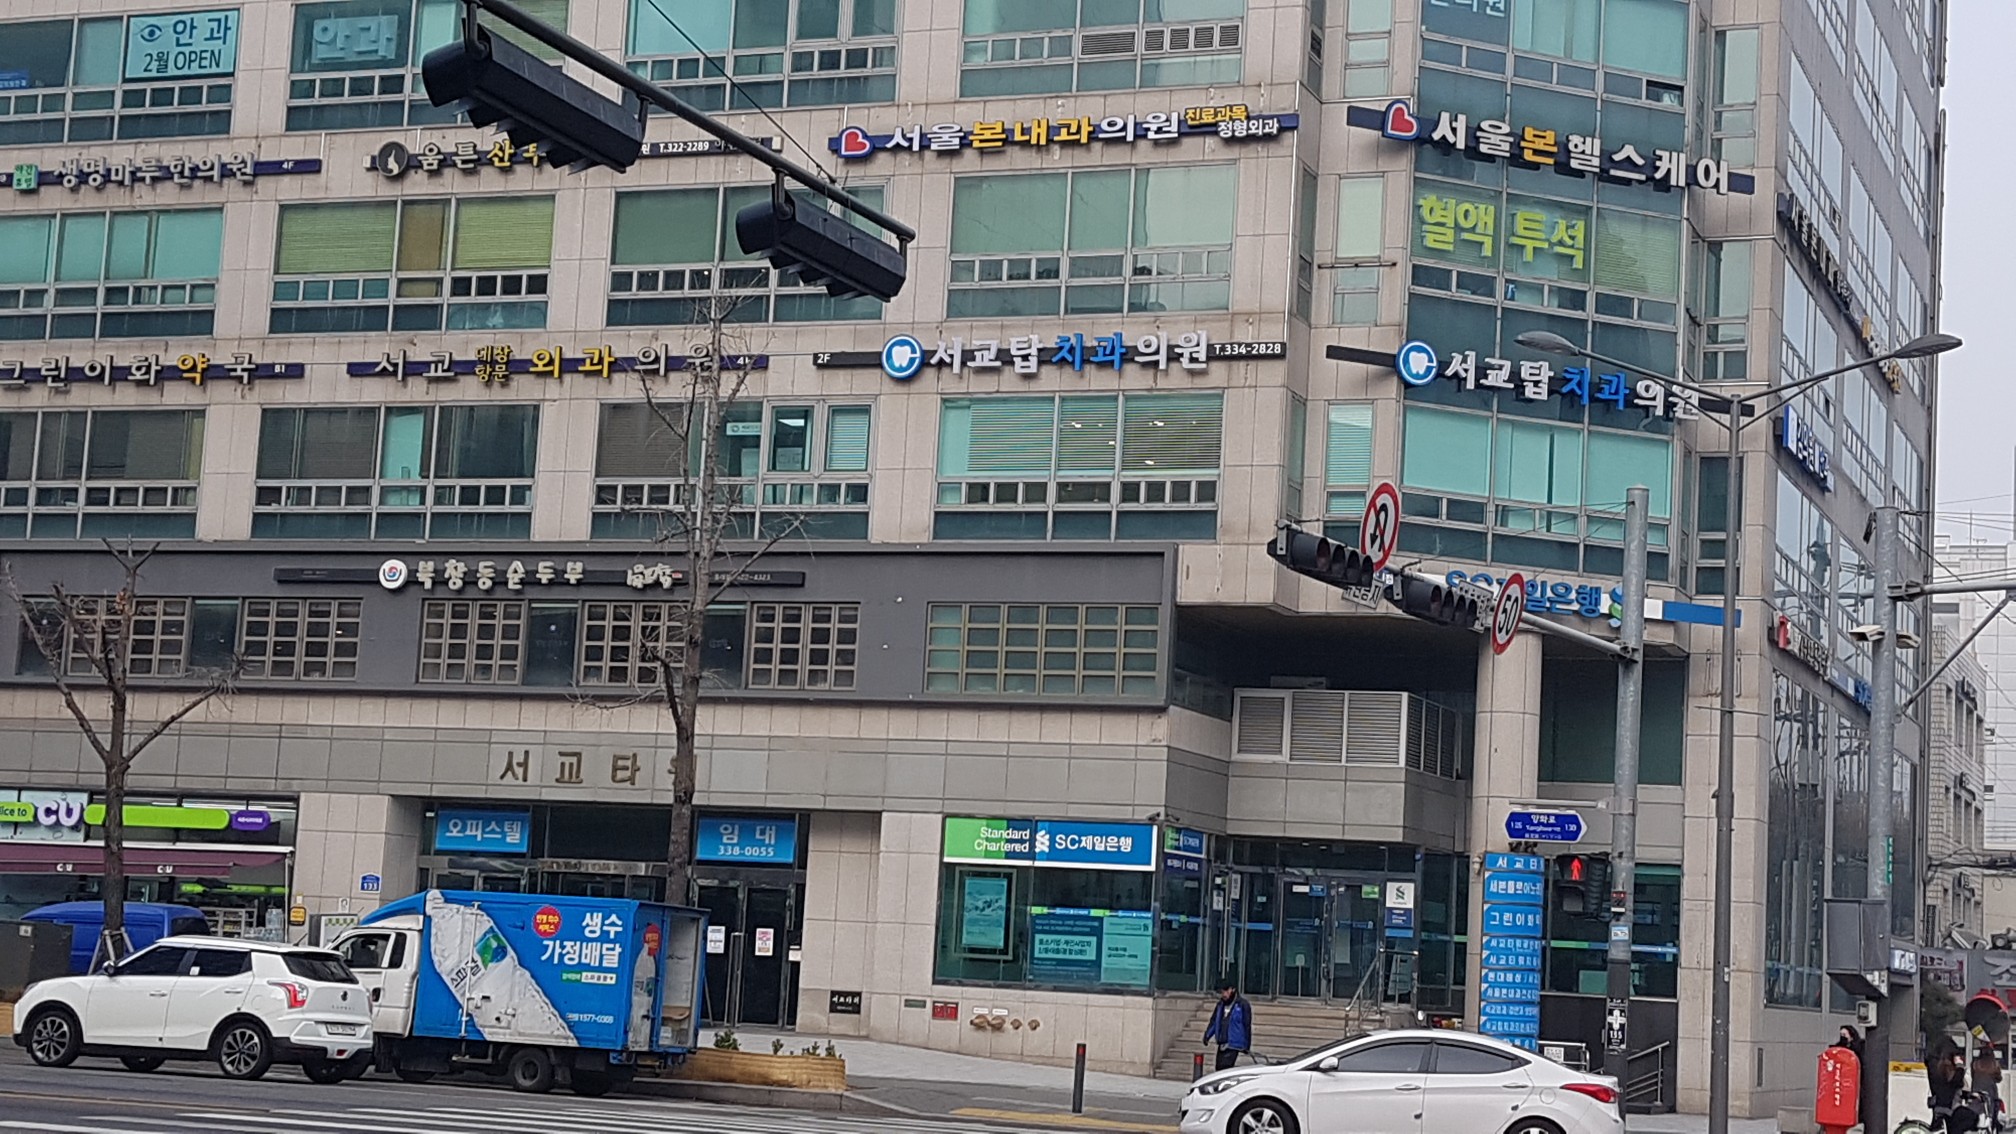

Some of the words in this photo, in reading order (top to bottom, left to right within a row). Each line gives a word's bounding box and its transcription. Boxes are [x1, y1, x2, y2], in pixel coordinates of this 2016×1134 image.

[172, 16, 232, 47] 안과
[312, 14, 395, 61] 안과
[143, 52, 170, 74] 2월
[173, 49, 221, 71] OPEN
[1185, 104, 1248, 125] 진료과목
[1217, 117, 1280, 139] 정형외과
[885, 111, 1180, 152] 서울본내과의원
[1431, 110, 1729, 194] 서울본헬스케어
[54, 152, 255, 188] 생명마루한의원
[281, 160, 294, 170] 4F
[1416, 194, 1496, 258] 혈액
[1508, 209, 1585, 270] 투석
[374, 347, 456, 381] 서교
[474, 344, 513, 363] 대장
[817, 354, 830, 364] 2F
[930, 330, 1208, 375] 서교탑치과의원
[1214, 342, 1282, 357] T.334-2828
[1, 352, 256, 388] 그린이화약국
[475, 363, 512, 383] 항문
[1444, 349, 1700, 420] 서교탑치과의원
[416, 560, 585, 592] 북창동순두부
[1446, 570, 1601, 618] S일은행
[1498, 594, 1520, 636] 50
[18, 807, 27, 817] to
[37, 800, 83, 827] CU
[445, 819, 522, 843] 오피스텔
[719, 823, 776, 845] 임대
[980, 827, 1030, 841] Standard
[1055, 834, 1133, 853] SC제일은행
[717, 845, 775, 857] 338-0055
[974, 839, 1030, 854] Chartered
[57, 863, 73, 872] CU
[157, 865, 173, 874] CU
[581, 912, 623, 939] 생수
[540, 940, 622, 968] 가정배달
